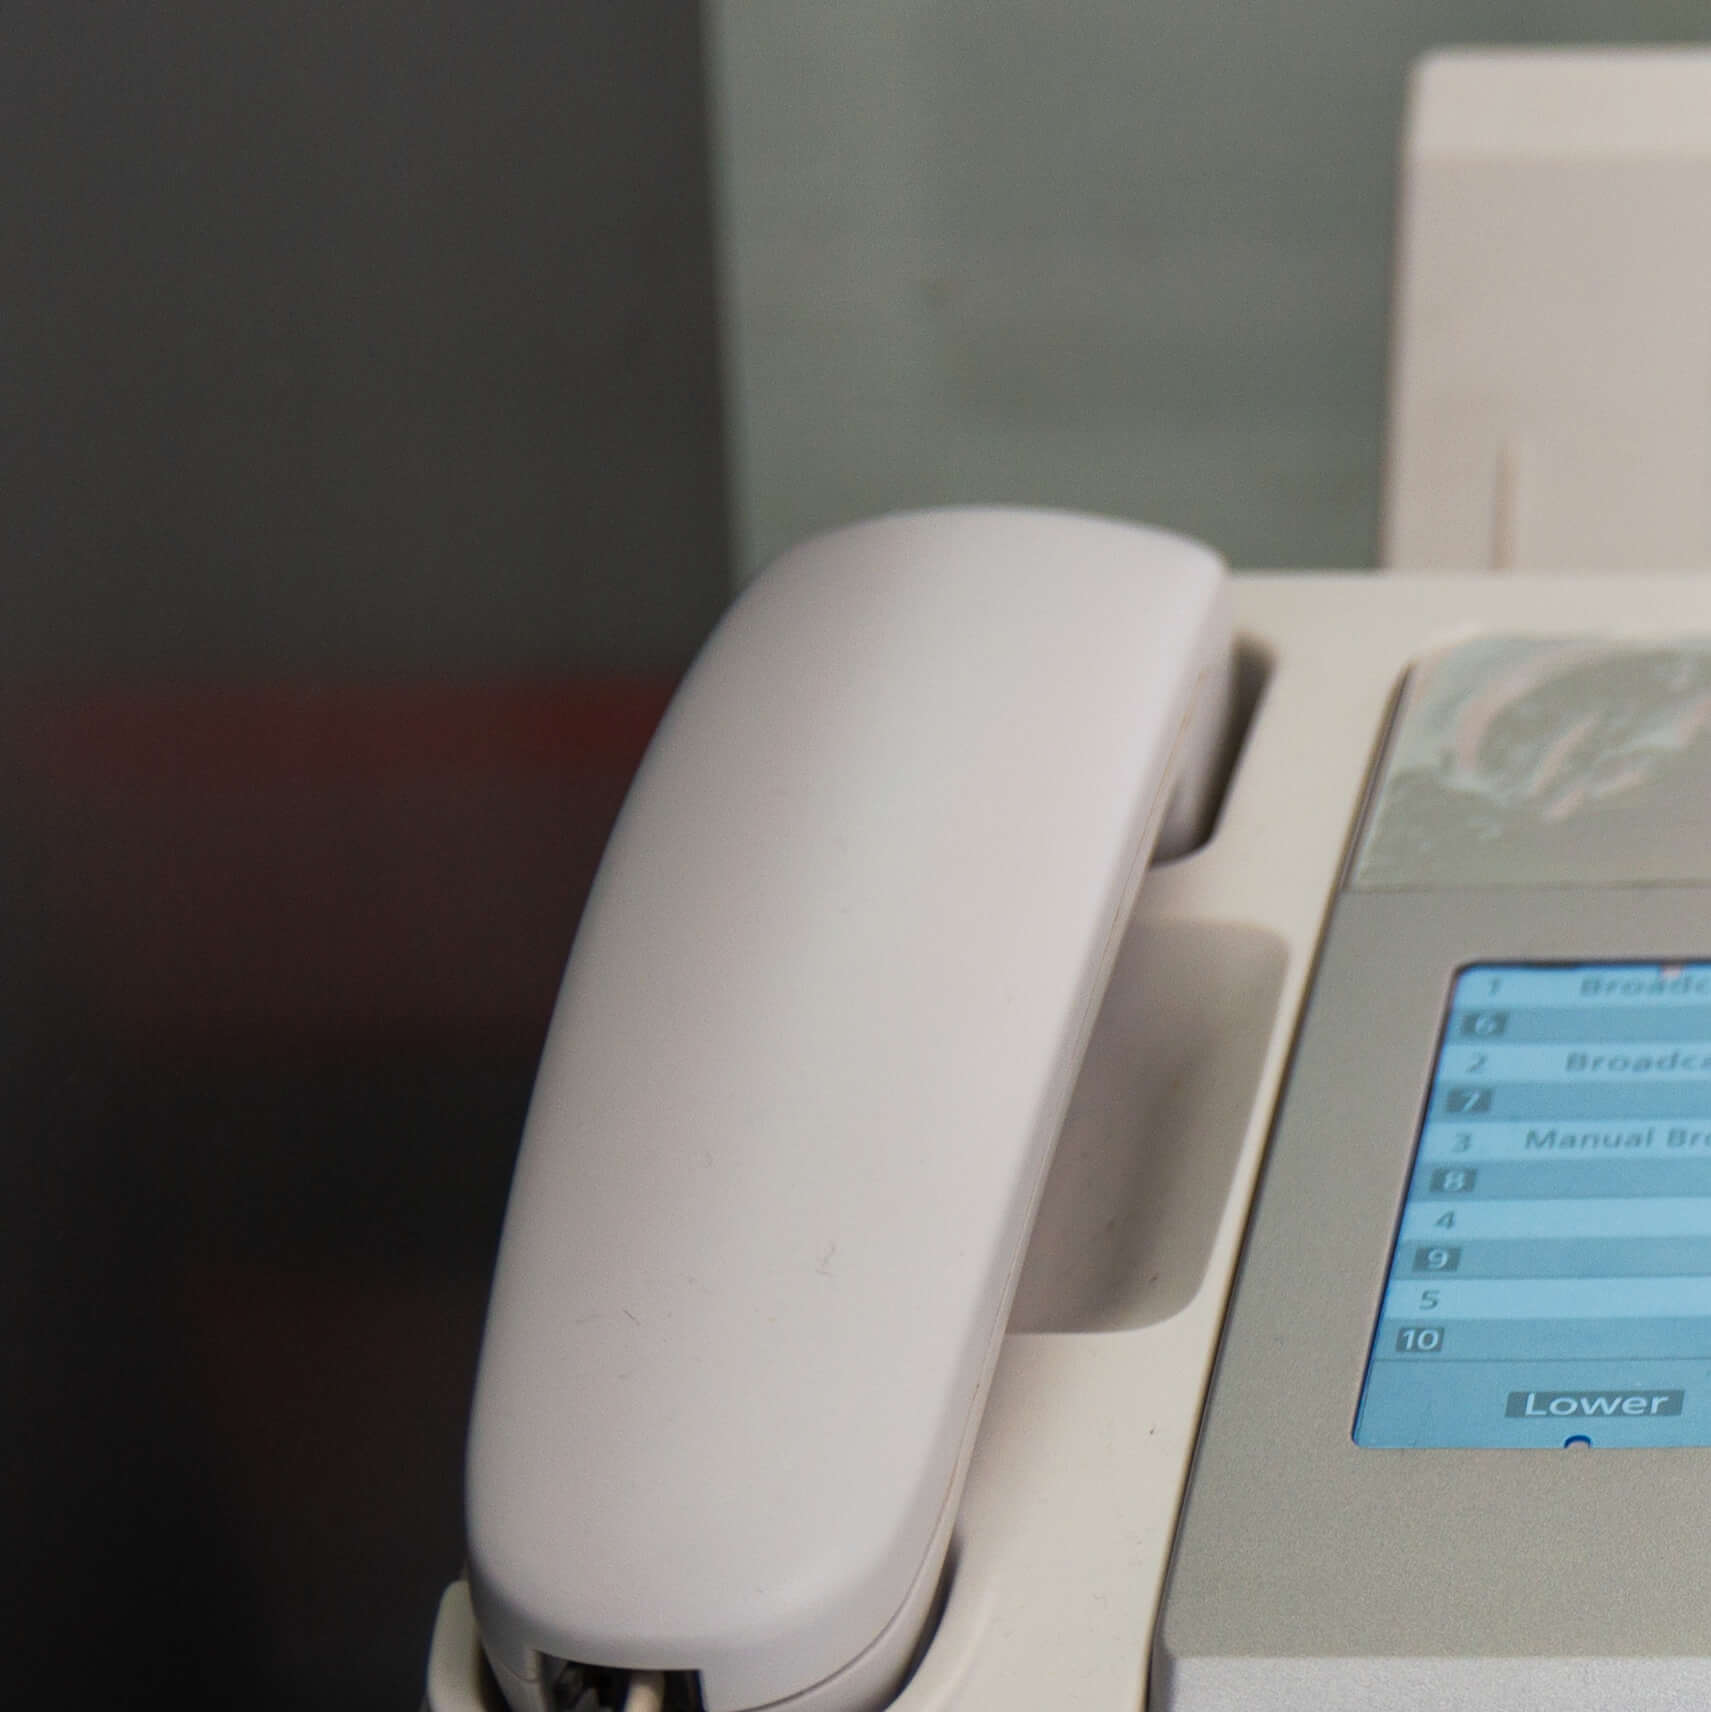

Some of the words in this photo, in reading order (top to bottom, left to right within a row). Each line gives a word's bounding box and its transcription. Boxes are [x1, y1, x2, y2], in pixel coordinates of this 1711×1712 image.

[1466, 1053, 1488, 1074] 2
[1452, 1132, 1472, 1153] 3
[1524, 1127, 1654, 1150] Manual
[1443, 1170, 1466, 1192] 8
[1435, 1210, 1456, 1230] 4
[1427, 1248, 1449, 1271] 9
[1419, 1289, 1439, 1311] 5
[1402, 1328, 1440, 1350] 10
[1523, 1391, 1669, 1417] Lower
